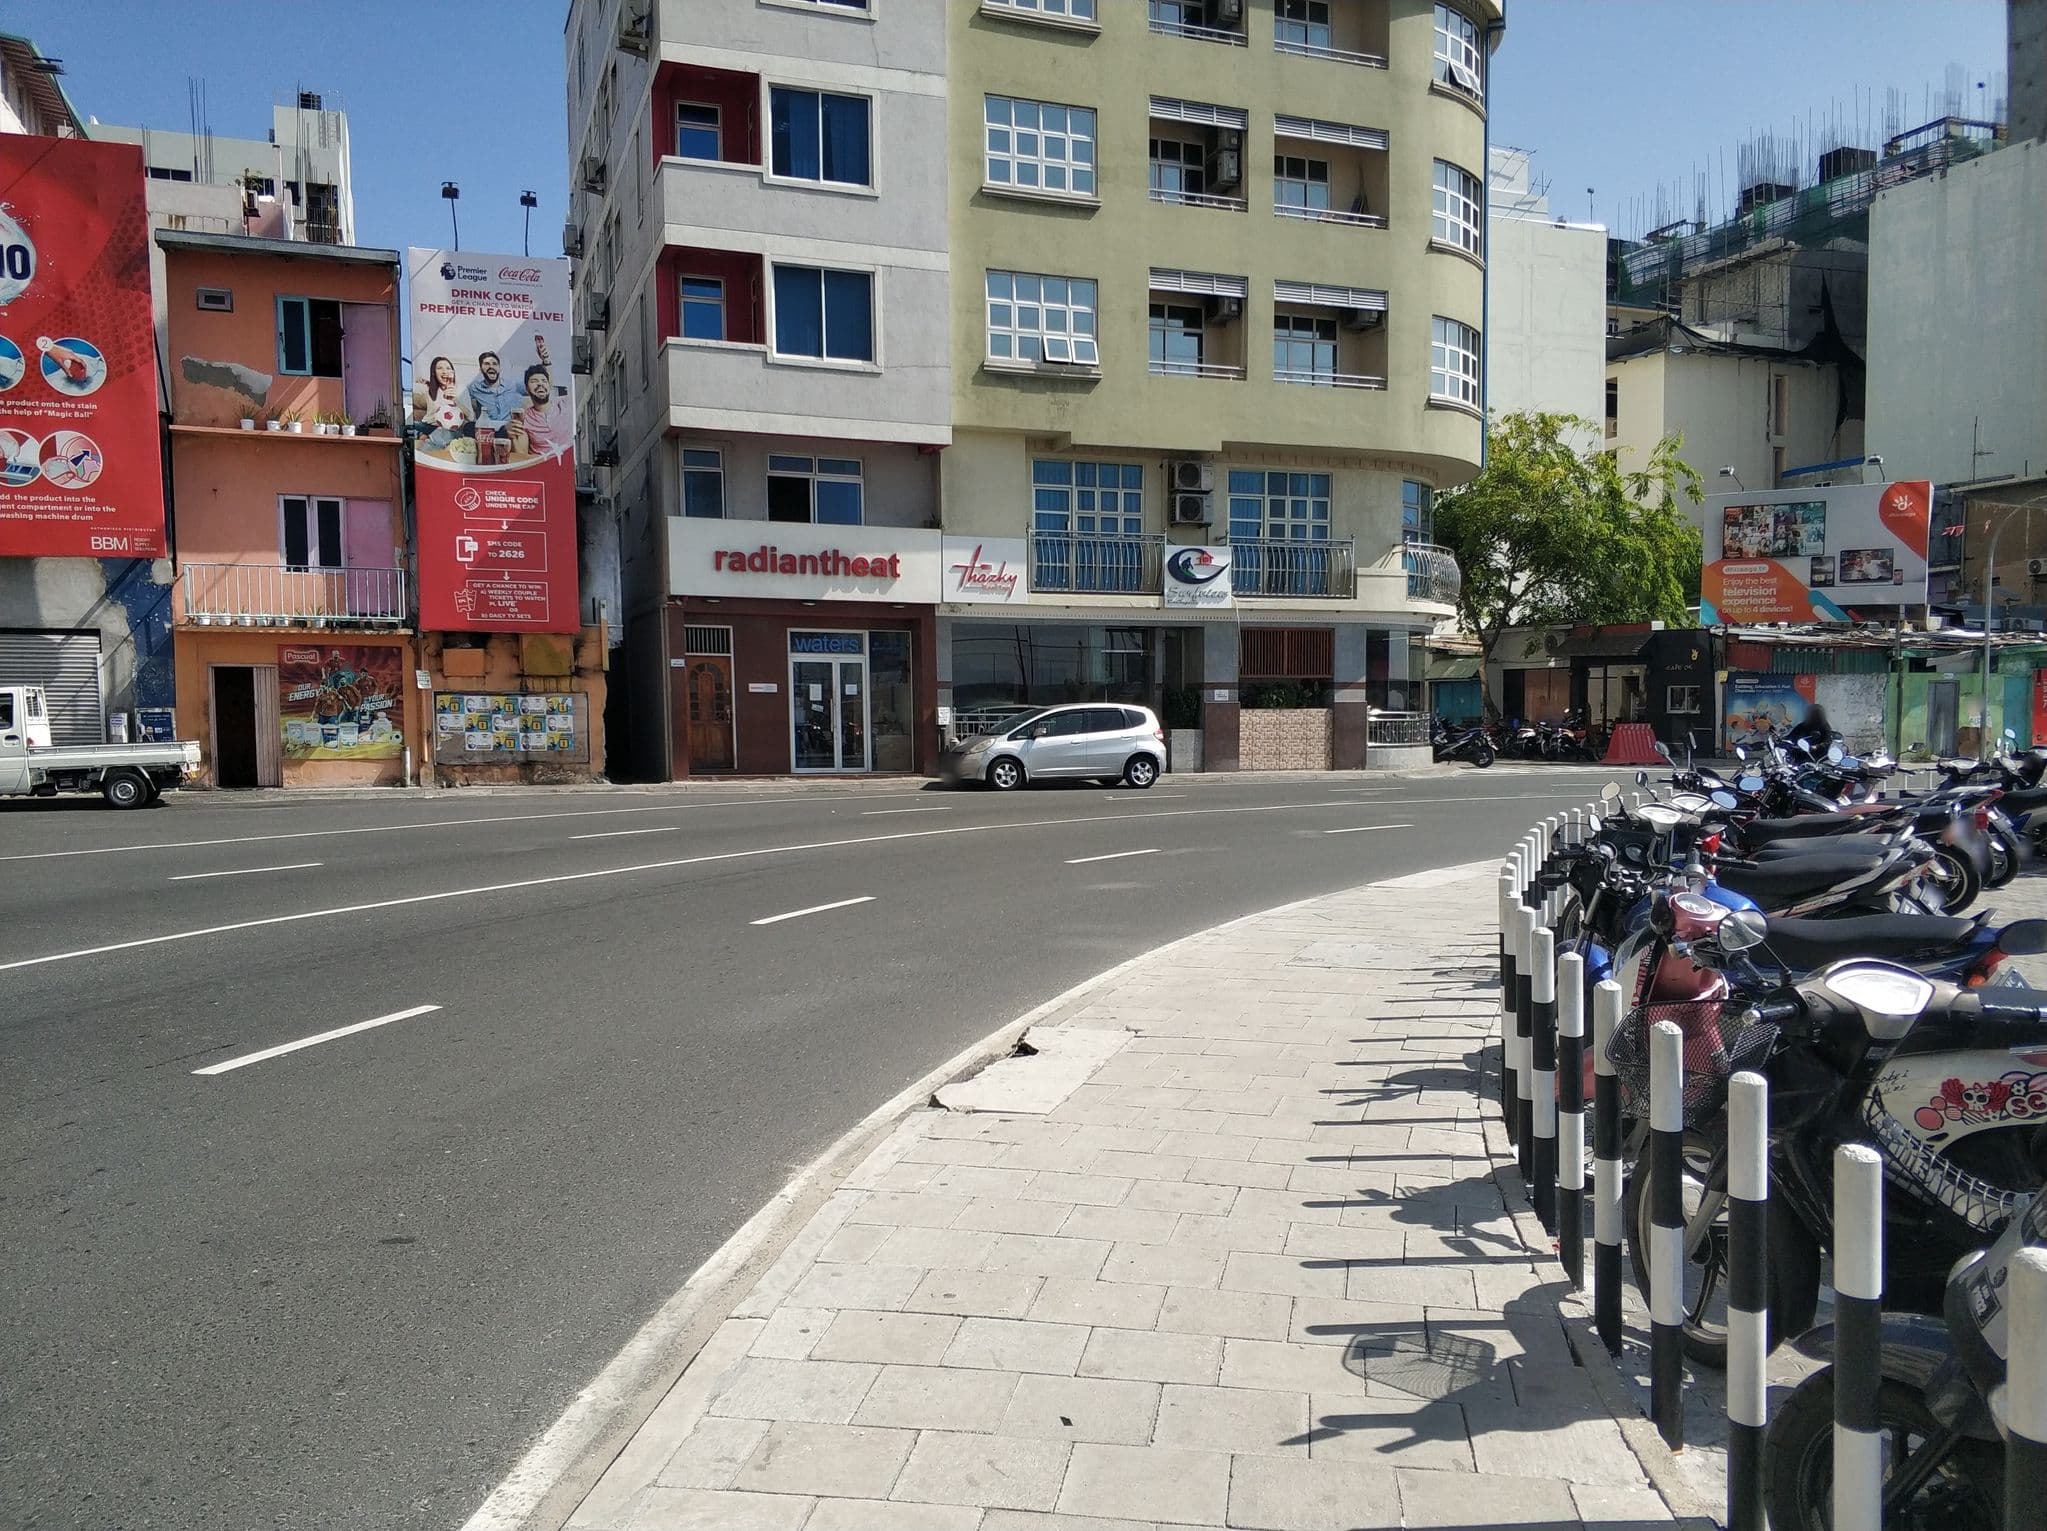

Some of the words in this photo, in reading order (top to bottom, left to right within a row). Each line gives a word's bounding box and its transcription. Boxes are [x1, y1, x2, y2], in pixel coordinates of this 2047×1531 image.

[458, 265, 487, 275] Premier
[458, 273, 487, 282] League
[451, 288, 490, 300] DRINK
[495, 292, 533, 305] COKE,
[420, 303, 475, 315] PREMIER
[480, 307, 529, 319] LEAGUE
[532, 311, 564, 321] LIVE!
[6, 399, 39, 407] product
[62, 400, 76, 409] the
[77, 402, 98, 410] stain
[14, 408, 32, 417] help
[30, 494, 61, 502] product
[485, 495, 516, 503] UNIQUE
[17, 504, 72, 512] compartment
[35, 512, 70, 520] machine
[71, 513, 93, 521] drum
[91, 536, 129, 551] BBM
[499, 550, 525, 559] 2626
[714, 546, 900, 578] radiantheat
[1723, 578, 1744, 586] Enjoy
[1723, 587, 1777, 596] television
[1722, 597, 1777, 606] experience
[1759, 605, 1793, 613] devices!
[795, 635, 859, 652] waters
[287, 652, 316, 660] Pascual
[298, 682, 312, 691] OUR
[288, 690, 322, 702] ENERGY
[360, 700, 394, 712] PASSION
